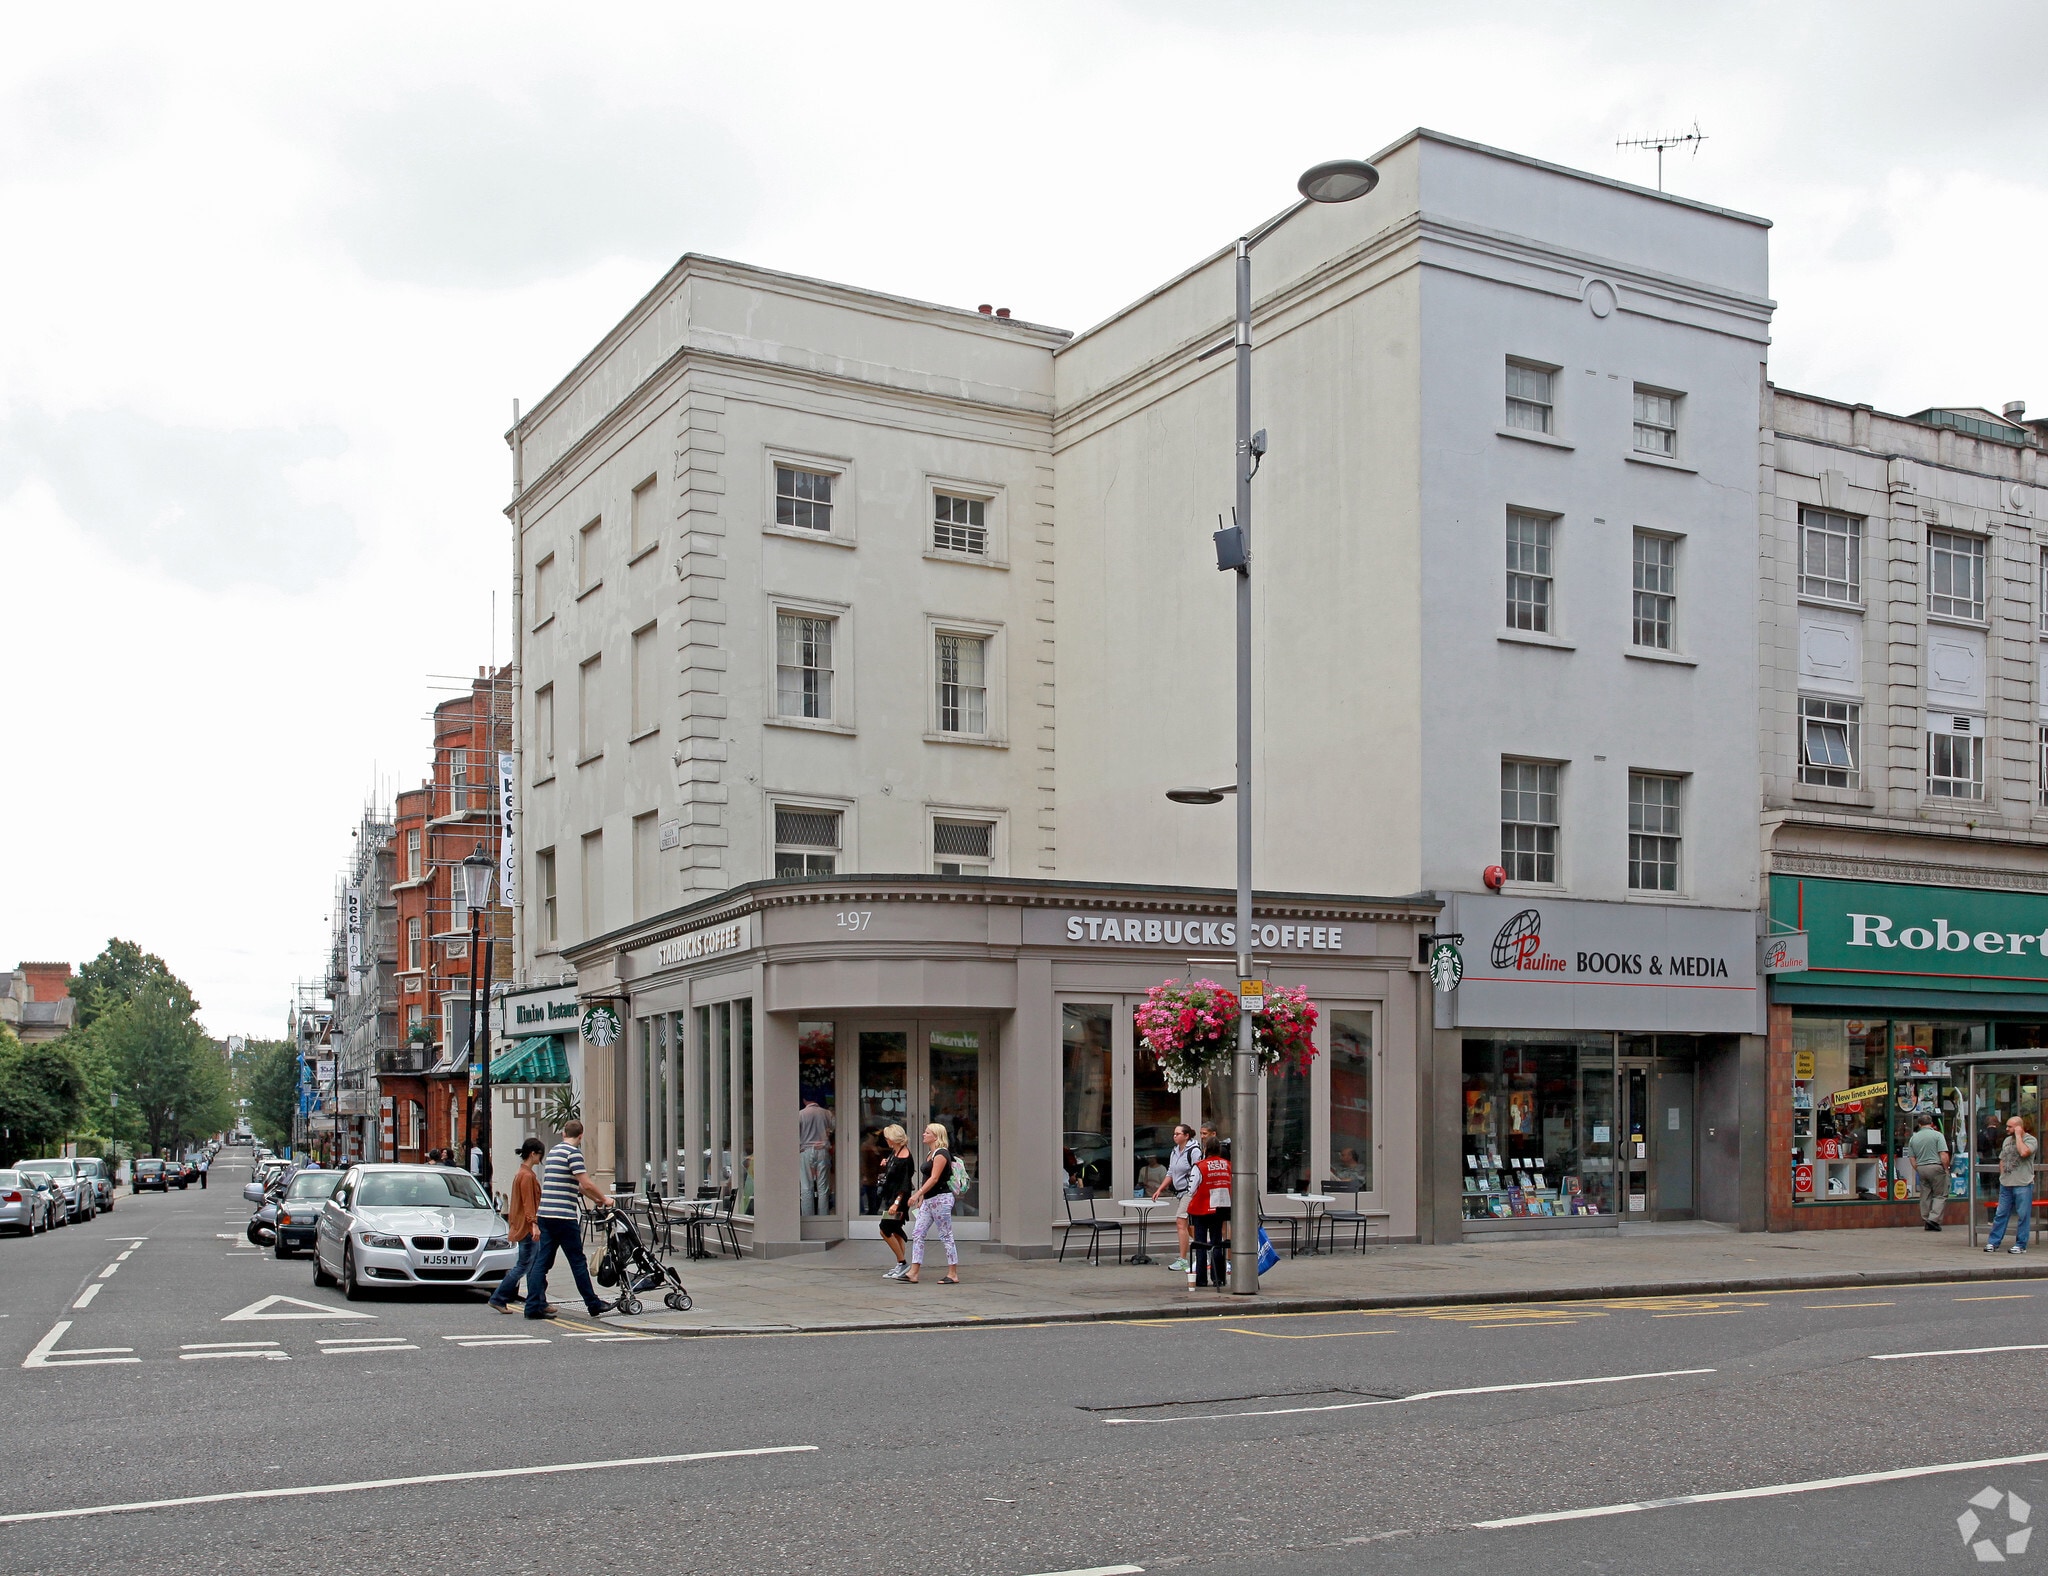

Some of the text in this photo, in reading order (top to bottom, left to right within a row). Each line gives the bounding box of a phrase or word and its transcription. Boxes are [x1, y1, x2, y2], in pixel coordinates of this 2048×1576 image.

[777, 617, 826, 630] AARONSON
[836, 911, 872, 931] 197
[1067, 916, 1343, 949] STARBUCKS COFFEE
[1846, 913, 2048, 958] Robert
[658, 924, 739, 966] STARBUCKS COFFEE
[1512, 934, 1729, 978] Pauline BOOKS & MEDIA
[1772, 951, 1804, 968] Pauline
[861, 1088, 907, 1098] SUMMER
[1835, 1093, 1851, 1103] New
[1851, 1090, 1867, 1099] lines
[1867, 1084, 1887, 1096] added
[881, 1098, 906, 1112] ON
[424, 1255, 468, 1264] WJ59 MTV
